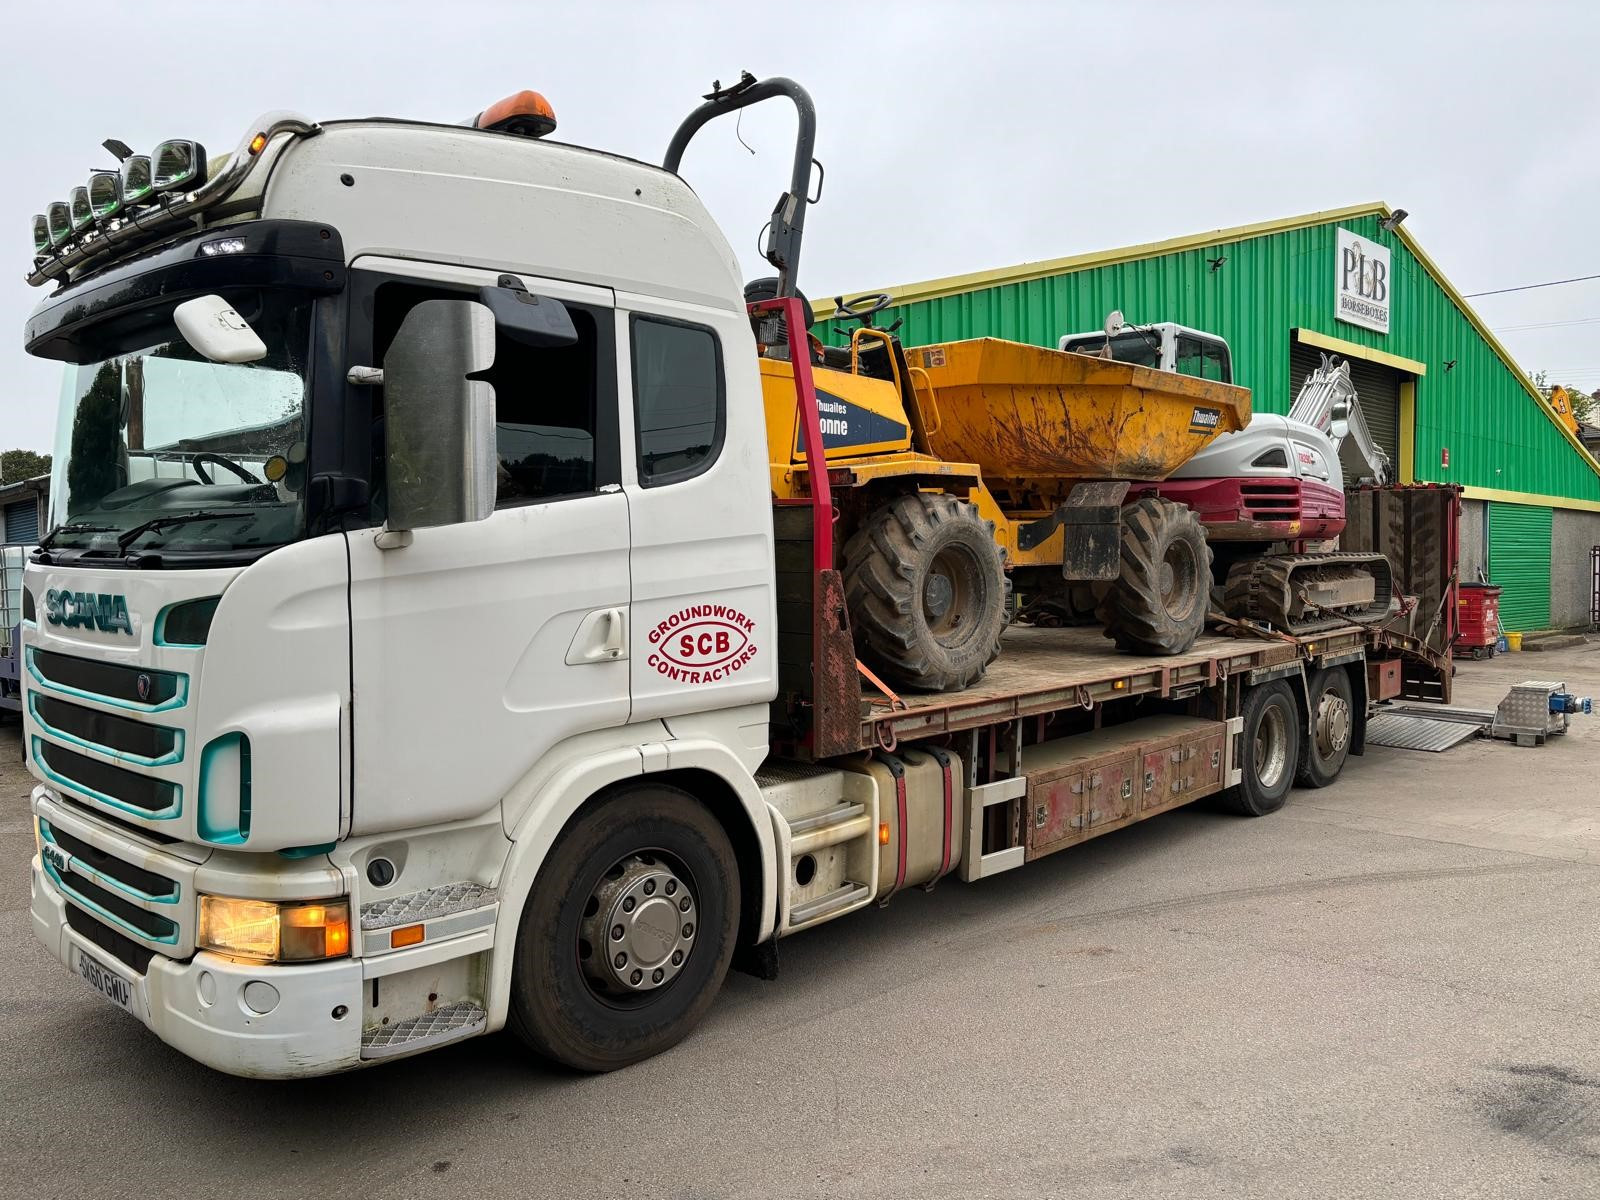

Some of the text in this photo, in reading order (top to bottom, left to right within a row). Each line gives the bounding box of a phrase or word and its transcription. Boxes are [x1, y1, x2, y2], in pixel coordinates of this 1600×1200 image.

[1342, 246, 1387, 301] PLB
[1342, 297, 1388, 322] HORSEBOXES
[819, 417, 848, 436] onne
[46, 588, 134, 636] SCANIA
[648, 604, 756, 645] GROUNDWORK
[679, 631, 731, 658] SCB
[647, 643, 758, 684] CONTRACTORS
[104, 973, 127, 1006] GWU
